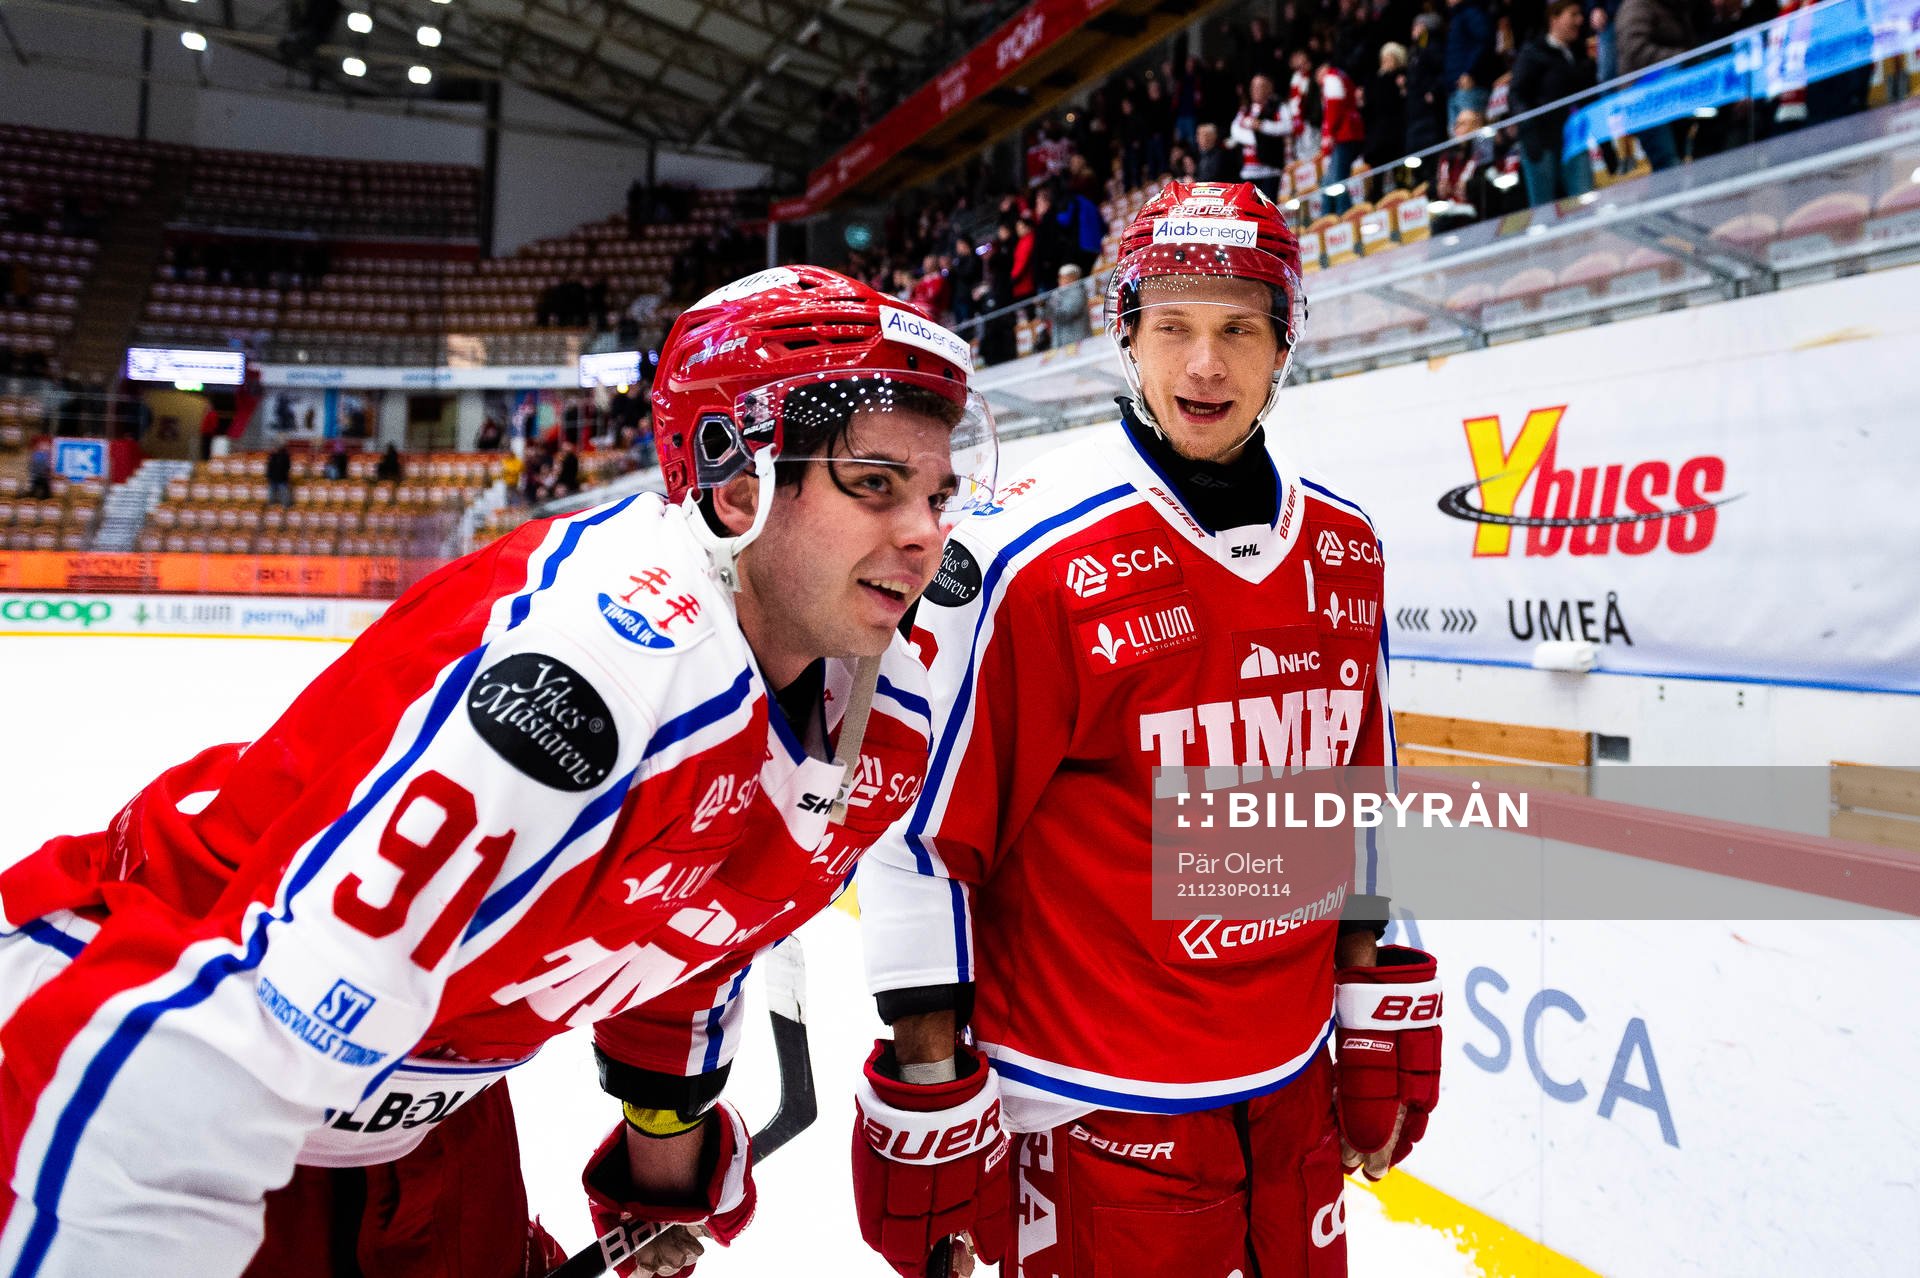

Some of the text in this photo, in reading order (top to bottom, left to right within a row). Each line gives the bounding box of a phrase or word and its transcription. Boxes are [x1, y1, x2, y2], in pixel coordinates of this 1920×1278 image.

[1111, 545, 1174, 577] SCA
[1231, 543, 1261, 558] SHL
[1348, 540, 1383, 567] SCA
[601, 602, 656, 647] TIMRÅ IK
[1125, 605, 1195, 648] LILIUM
[1508, 592, 1634, 646] UMEÅ
[1279, 651, 1320, 674] NHC
[797, 793, 836, 815] SH
[333, 769, 517, 973] 91
[1221, 881, 1348, 948] consembly
[319, 982, 370, 1030] ST
[1463, 966, 1681, 1150] SCA
[1068, 1124, 1175, 1160] BAUER
